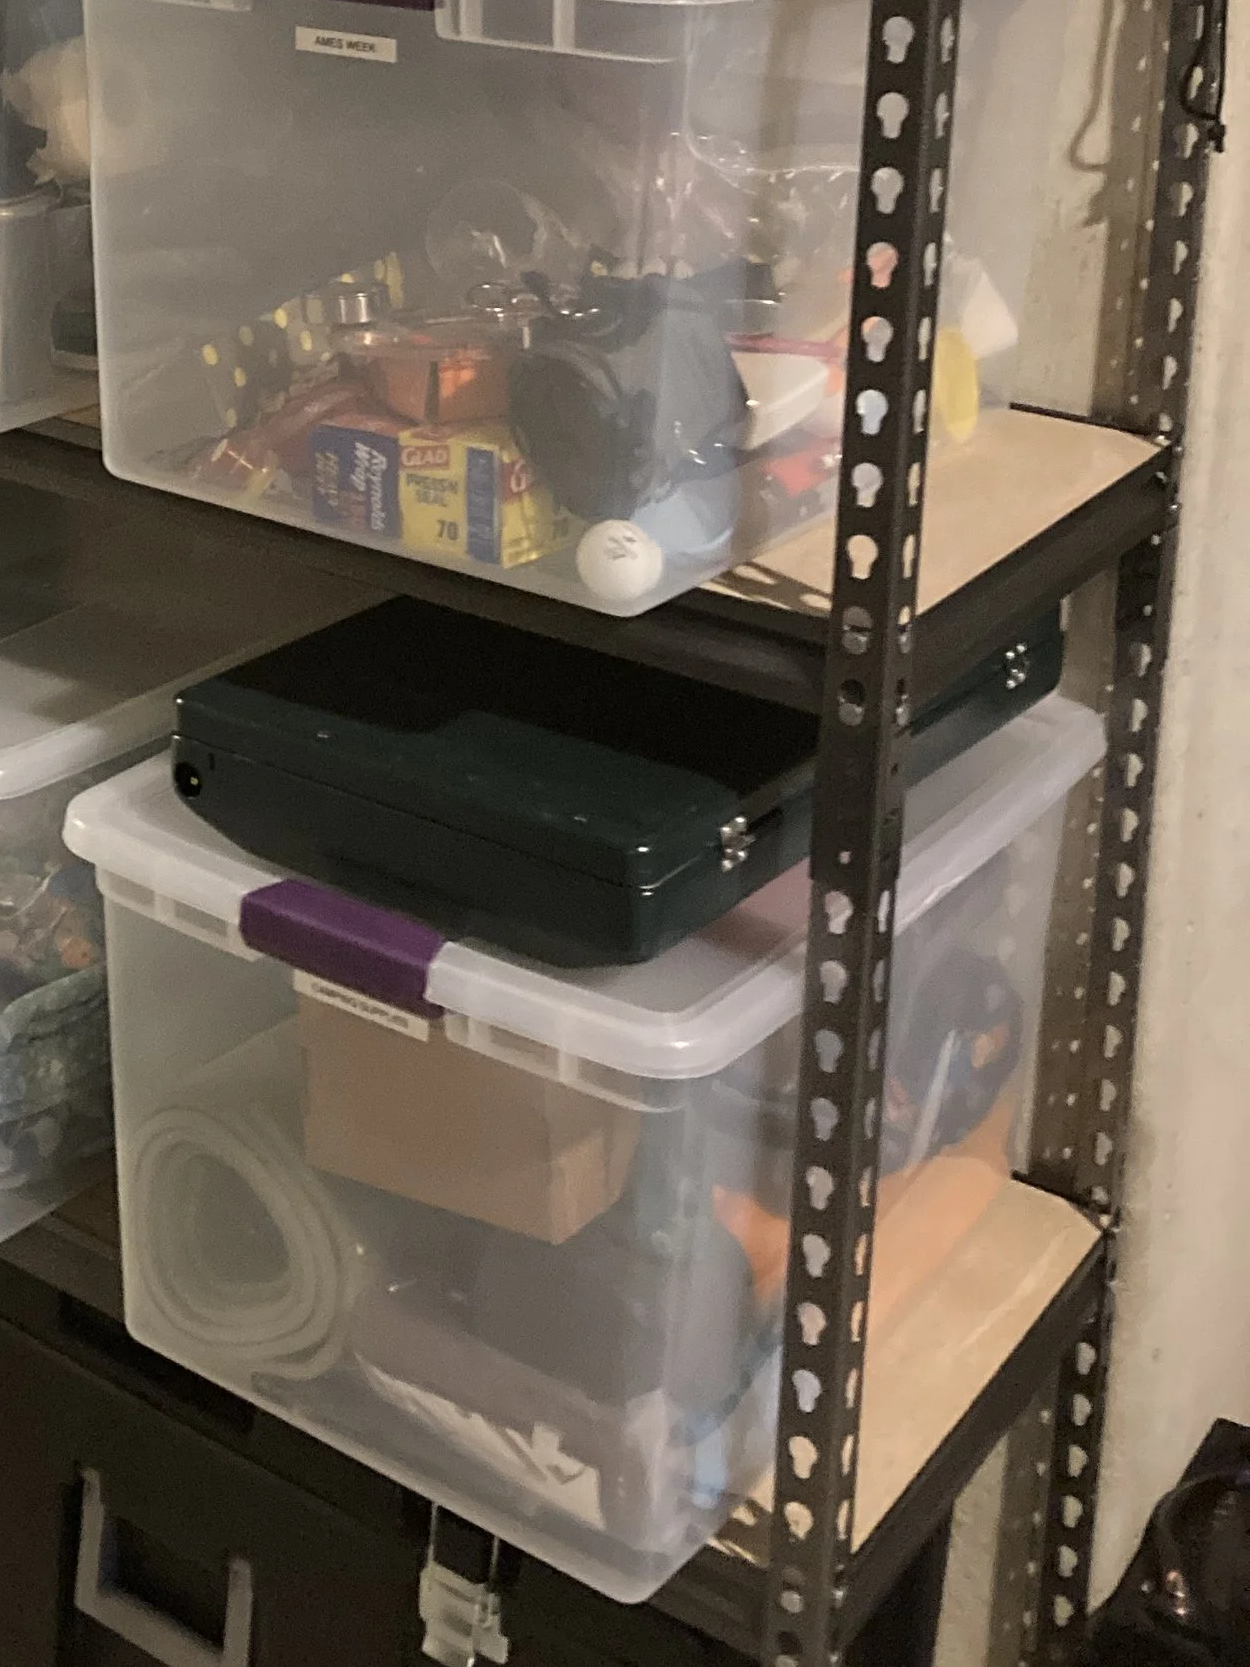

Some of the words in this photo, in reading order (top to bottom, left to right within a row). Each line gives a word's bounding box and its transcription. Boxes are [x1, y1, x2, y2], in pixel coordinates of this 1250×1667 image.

[314, 35, 344, 49] AMES
[344, 39, 377, 53] WEEK
[349, 441, 371, 492] Wrap
[400, 444, 449, 467] GLAD
[369, 445, 388, 531] Reynolds
[436, 519, 459, 541] 70
